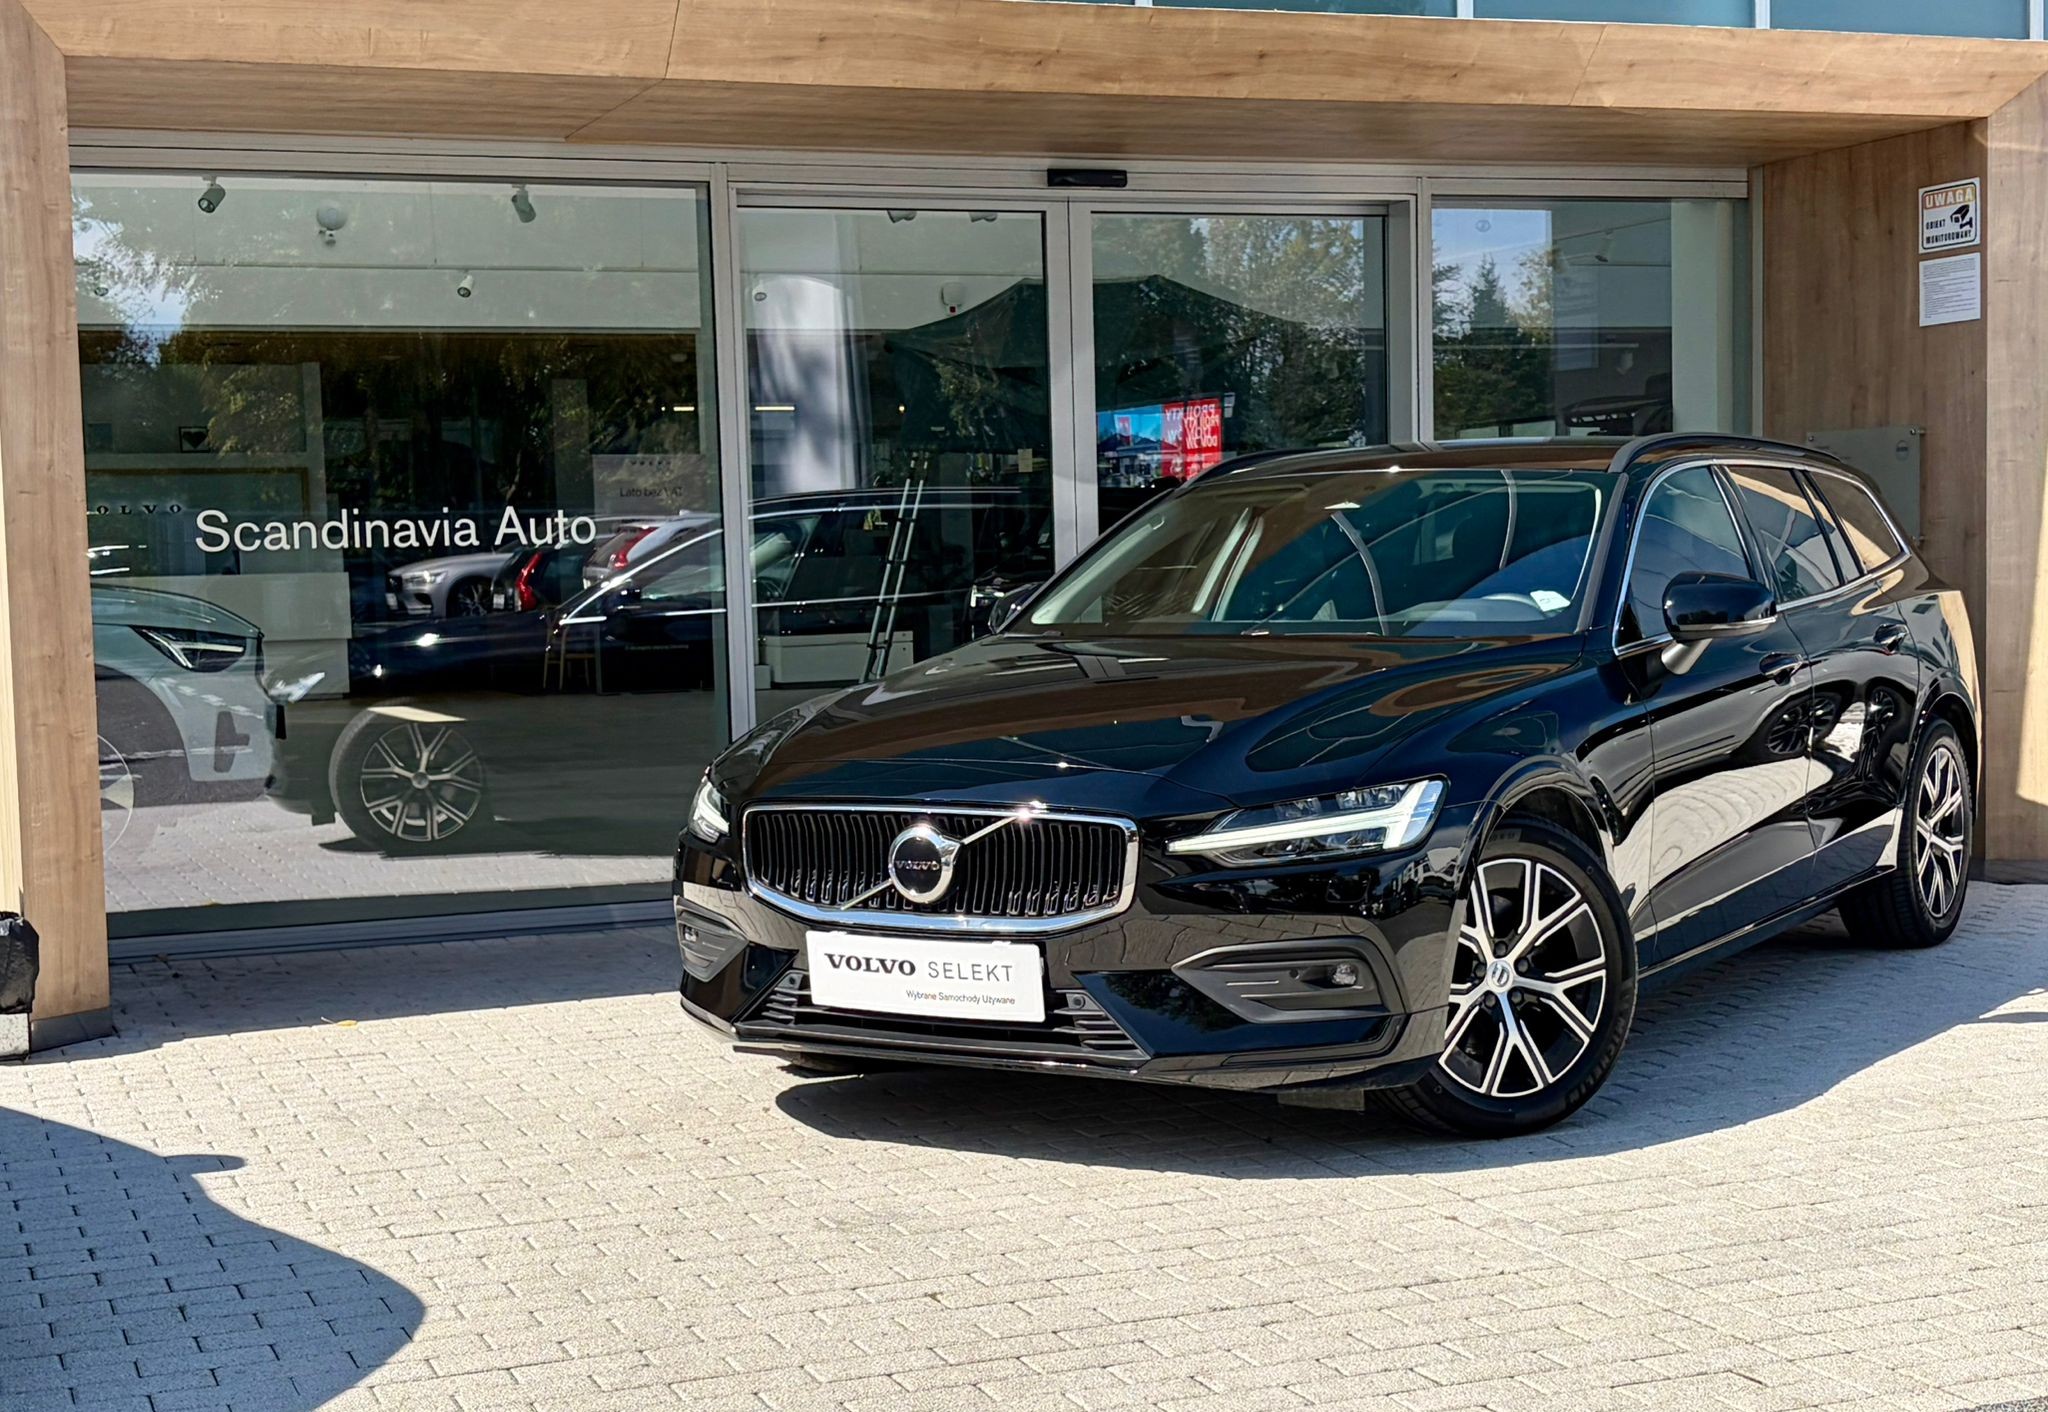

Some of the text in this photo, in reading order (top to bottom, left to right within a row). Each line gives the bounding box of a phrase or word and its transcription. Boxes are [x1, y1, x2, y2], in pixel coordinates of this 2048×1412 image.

[1925, 188, 1973, 208] UWAGA
[1926, 219, 1946, 230] OBIEKT
[96, 504, 182, 515] OLVO
[195, 505, 597, 553] Scandinavia Auto
[895, 860, 940, 871] VOLVO
[824, 953, 1013, 982] VOLVO SELEKT
[906, 990, 937, 1000] Wybrane
[938, 992, 981, 1005] Samochody
